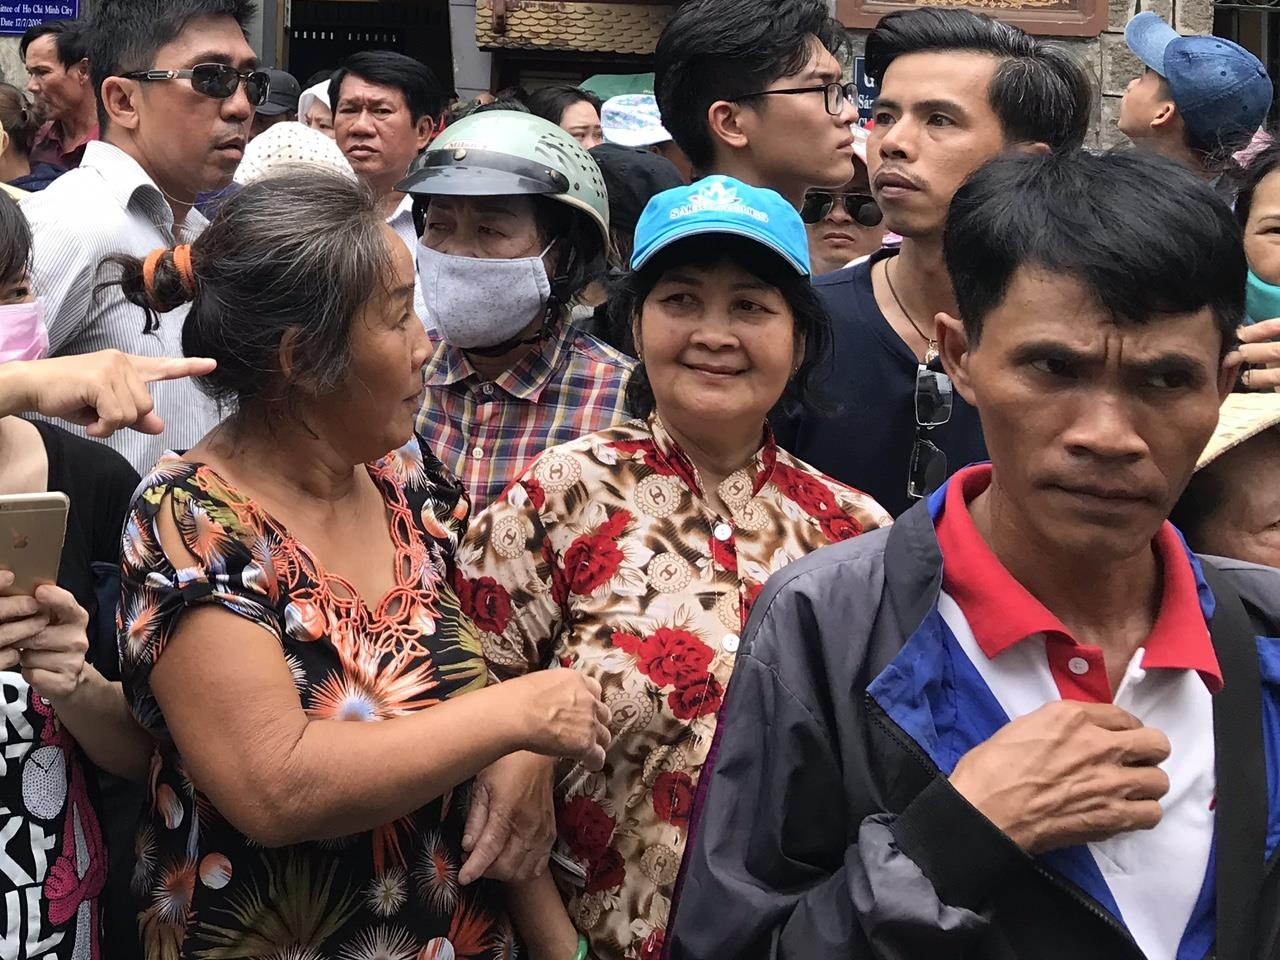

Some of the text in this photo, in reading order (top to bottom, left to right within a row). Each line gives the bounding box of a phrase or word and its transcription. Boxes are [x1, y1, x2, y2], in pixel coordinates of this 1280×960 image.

[14, 3, 21, 13] of
[22, 4, 32, 13] Ho
[32, 4, 43, 14] Chi
[44, 4, 60, 15] Minh
[61, 5, 73, 17] City
[0, 17, 14, 27] Date
